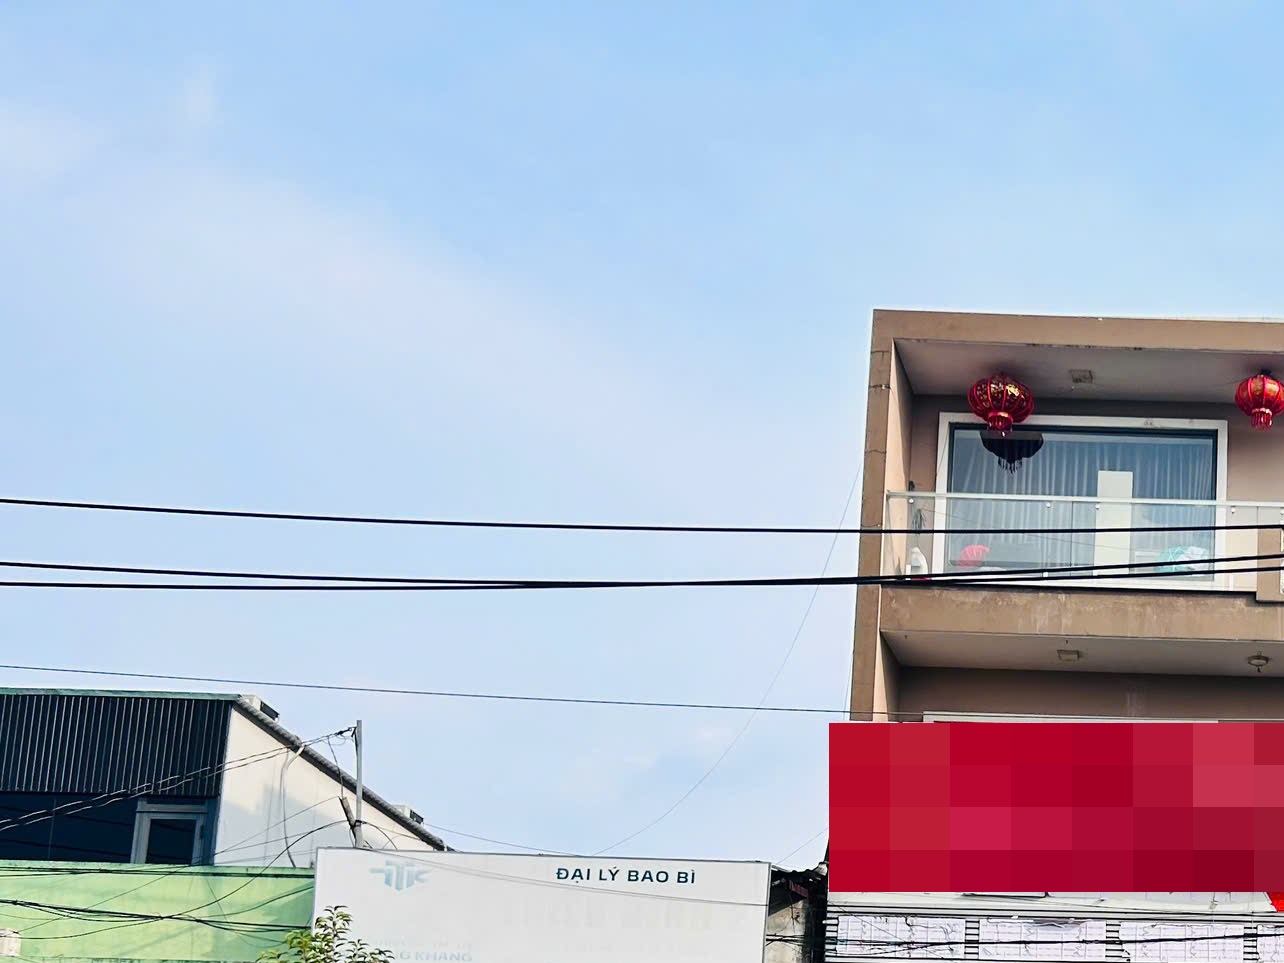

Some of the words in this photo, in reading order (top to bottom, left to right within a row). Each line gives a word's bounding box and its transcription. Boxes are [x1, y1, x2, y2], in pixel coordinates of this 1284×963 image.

[556, 867, 590, 883] ĐẠI
[599, 866, 620, 881] LÝ
[628, 869, 669, 883] BAO
[677, 869, 696, 884] BÌ
